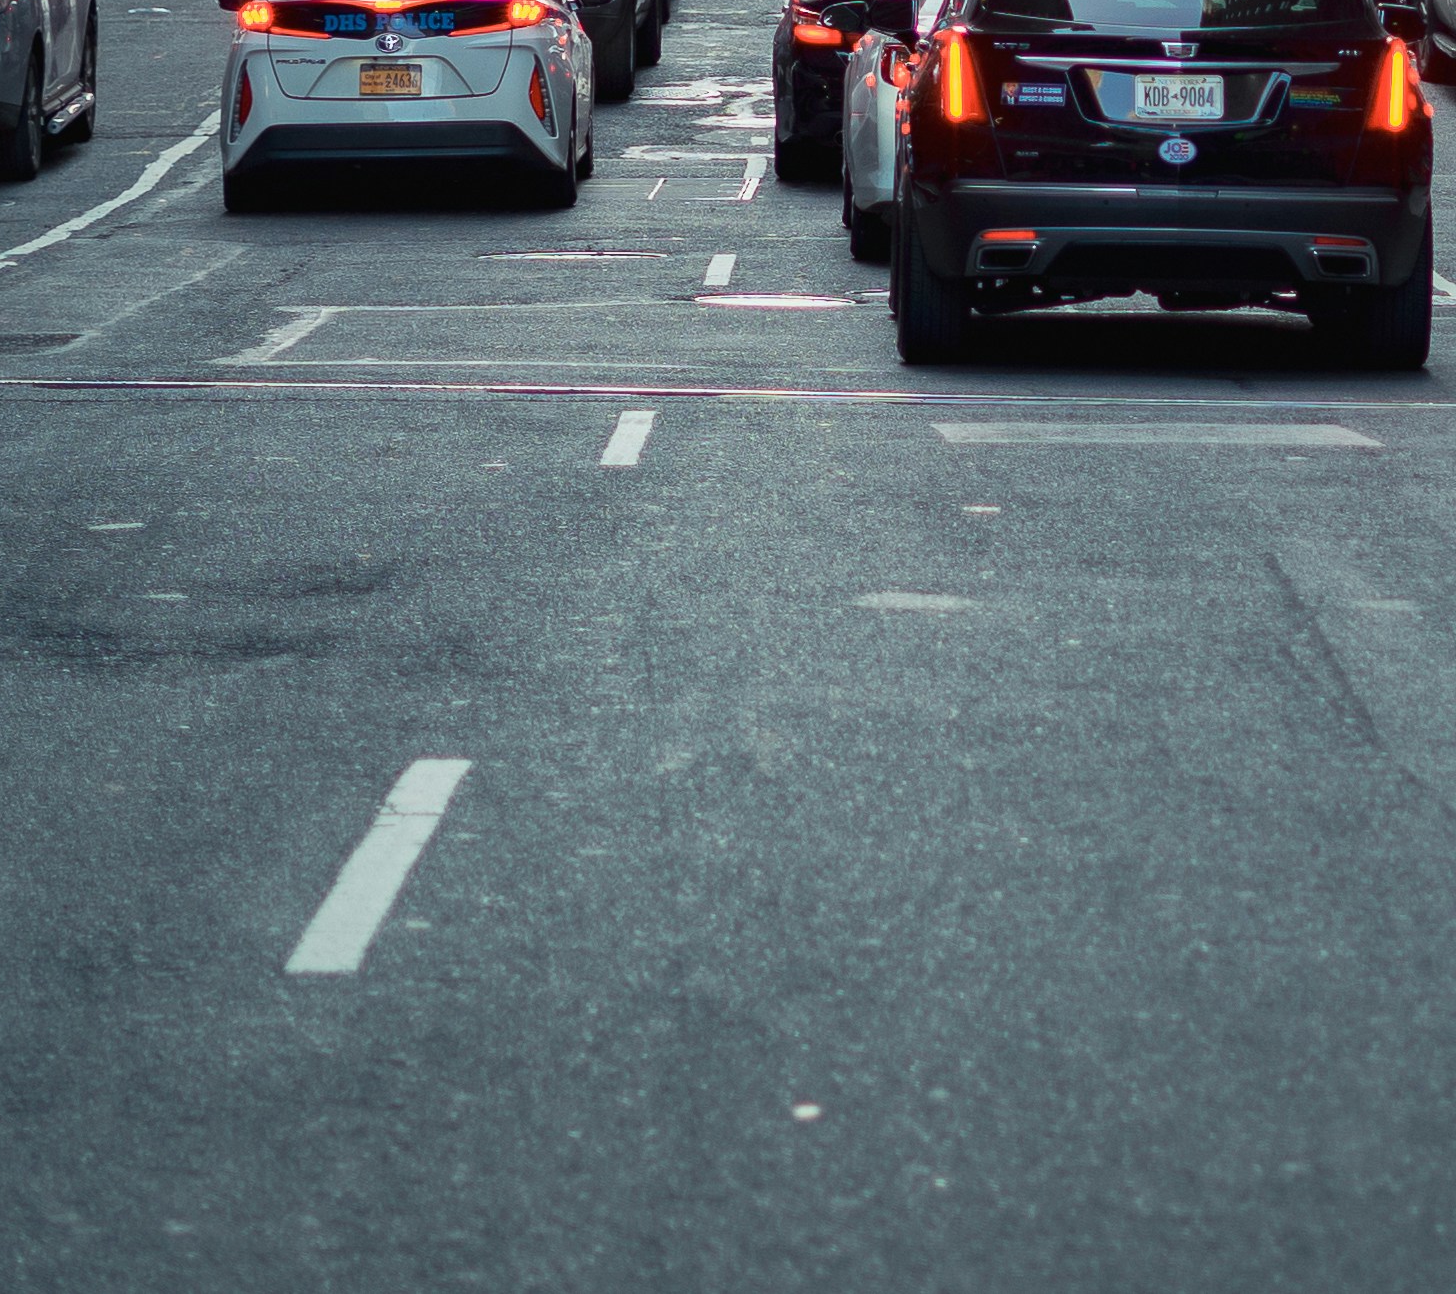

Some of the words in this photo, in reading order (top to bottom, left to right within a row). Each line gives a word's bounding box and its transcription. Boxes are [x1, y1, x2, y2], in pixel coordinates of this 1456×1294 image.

[323, 12, 368, 32] DHS
[375, 11, 456, 31] POLICE
[1144, 85, 1170, 108] KDB
[1179, 85, 1214, 108] 9084
[1164, 142, 1189, 155] JOE
[1169, 153, 1189, 161] 2020
